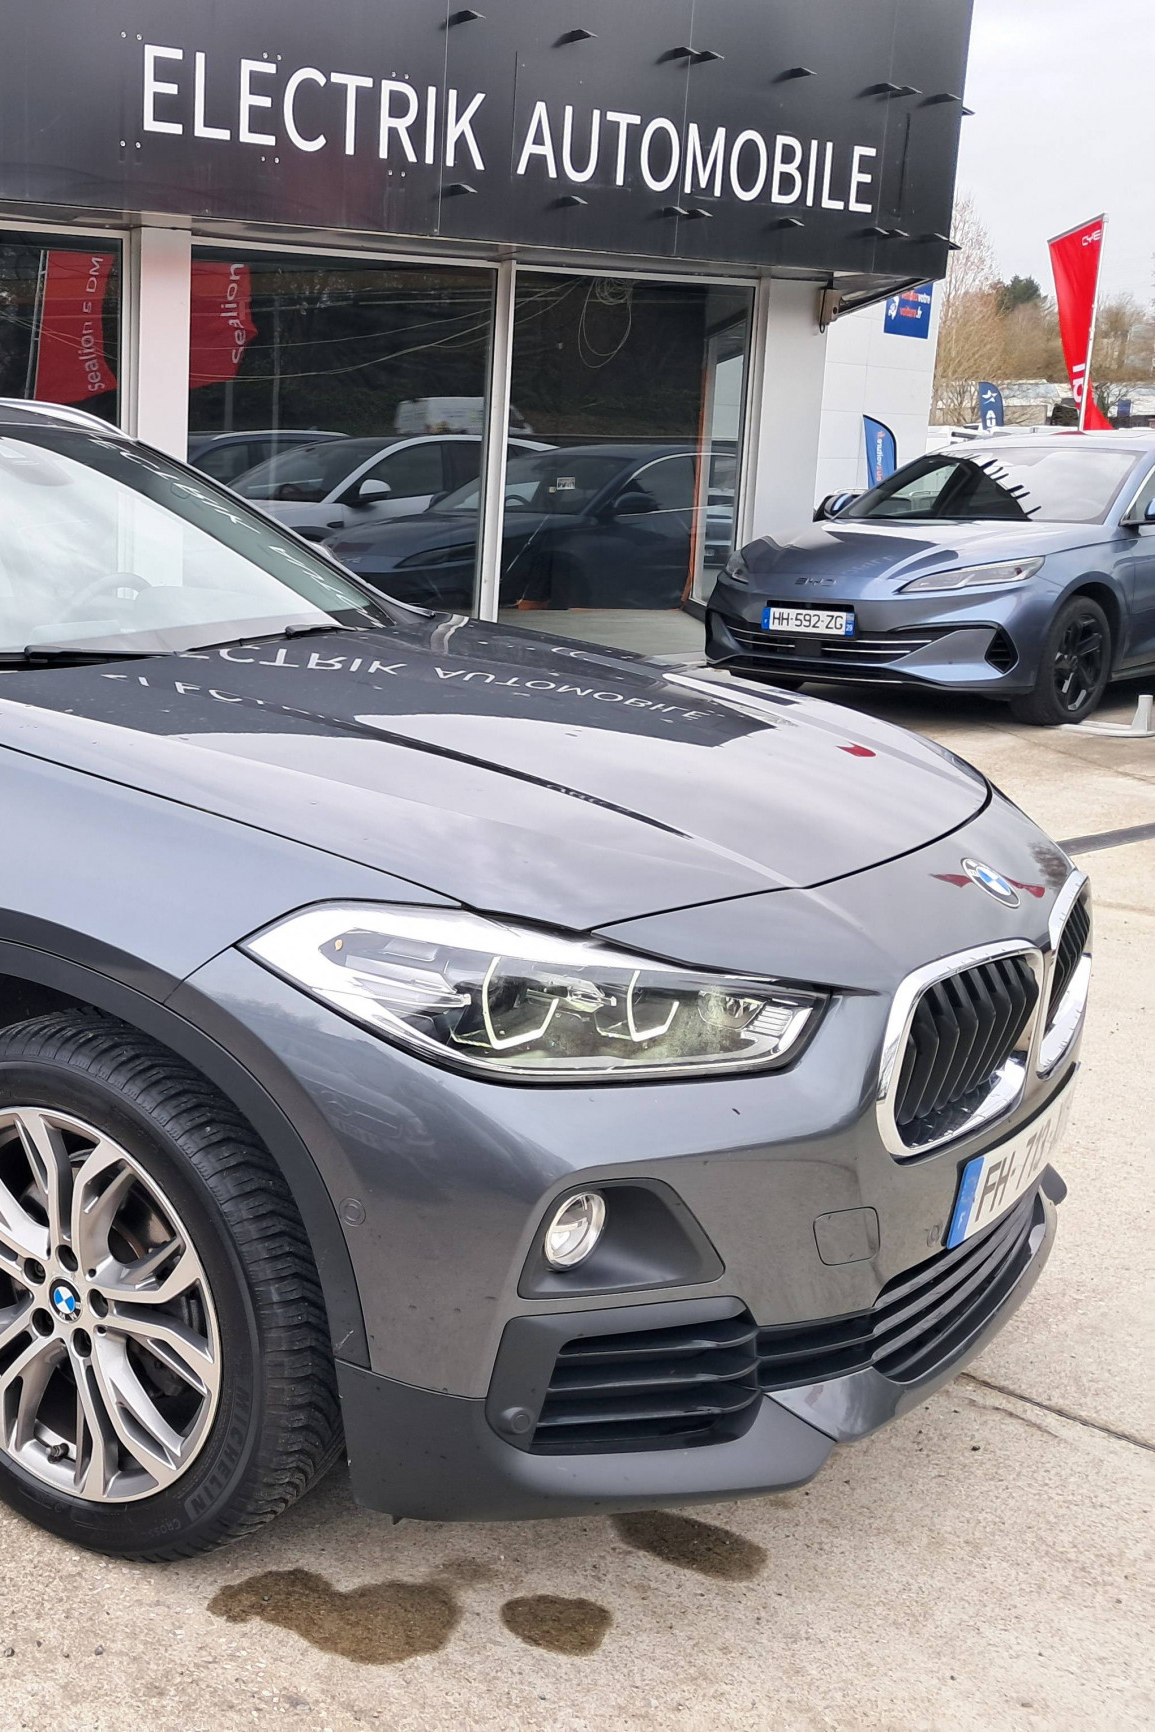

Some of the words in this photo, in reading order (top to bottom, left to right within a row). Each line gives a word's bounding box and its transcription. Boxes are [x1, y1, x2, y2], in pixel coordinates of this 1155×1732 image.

[142, 44, 486, 172] ELECTRIK
[516, 100, 877, 215] AUTOMOBILE
[77, 321, 106, 392] sealion
[771, 611, 844, 630] HH-592-ZG
[190, 1387, 253, 1516] MICHELIN
